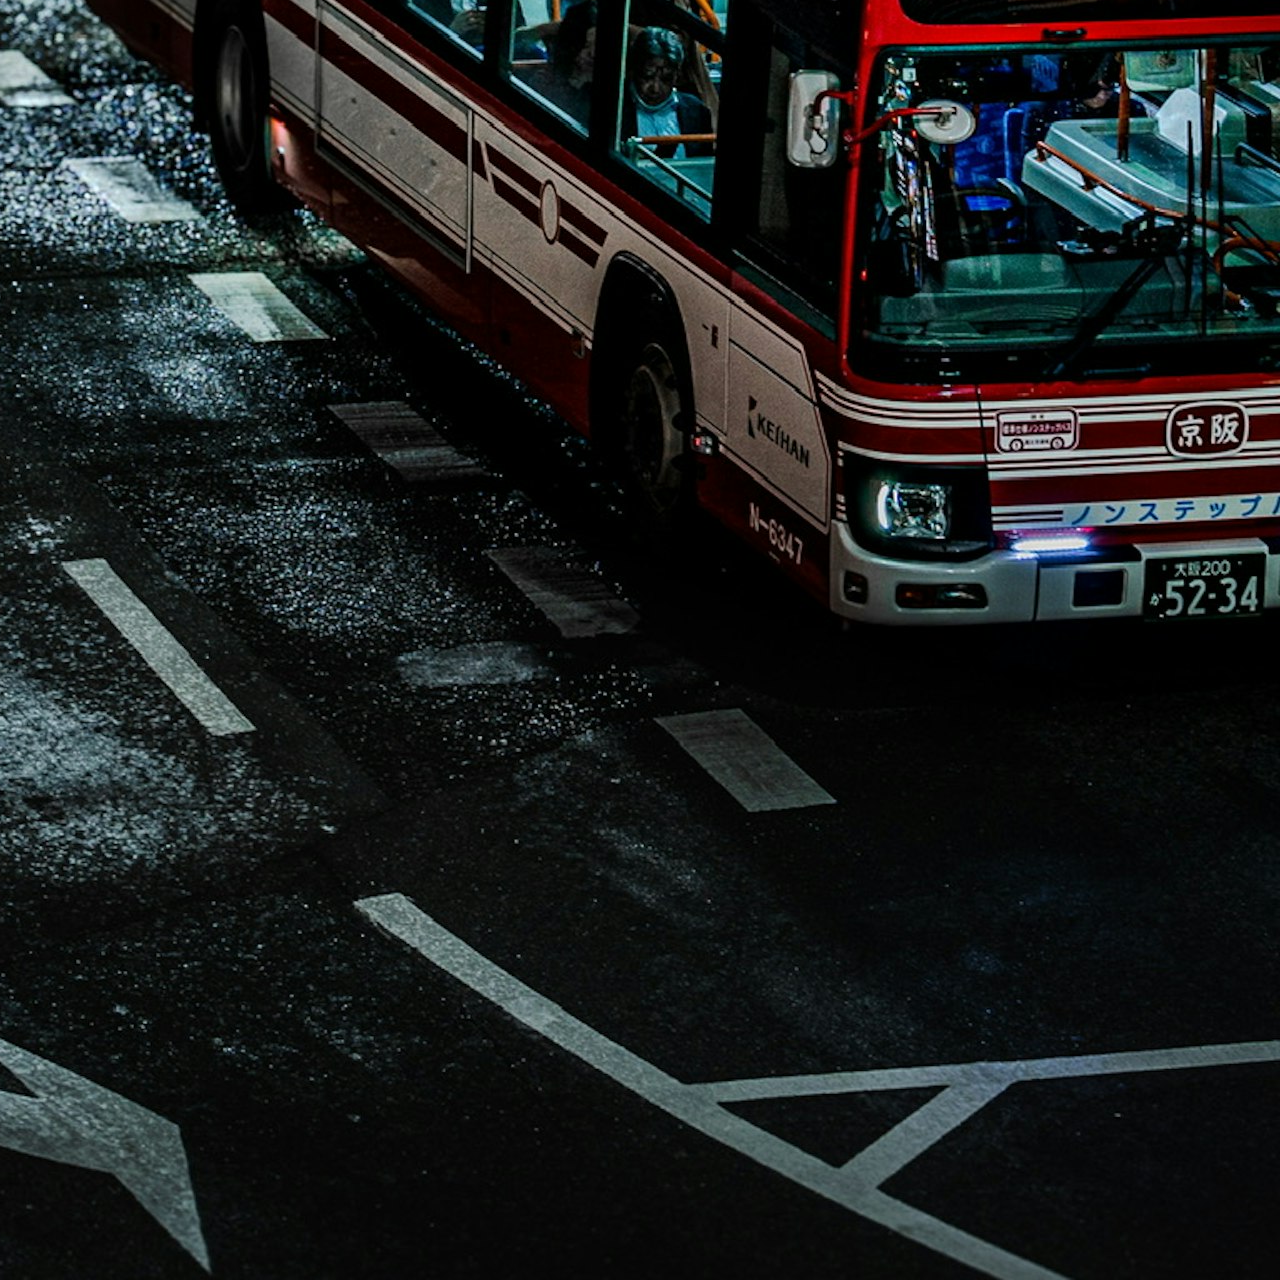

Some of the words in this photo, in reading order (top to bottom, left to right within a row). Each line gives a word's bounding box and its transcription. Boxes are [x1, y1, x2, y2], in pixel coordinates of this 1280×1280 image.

[757, 413, 810, 468] KEIHAN
[1175, 411, 1241, 449] 京阪
[1165, 576, 1259, 617] 52-34
